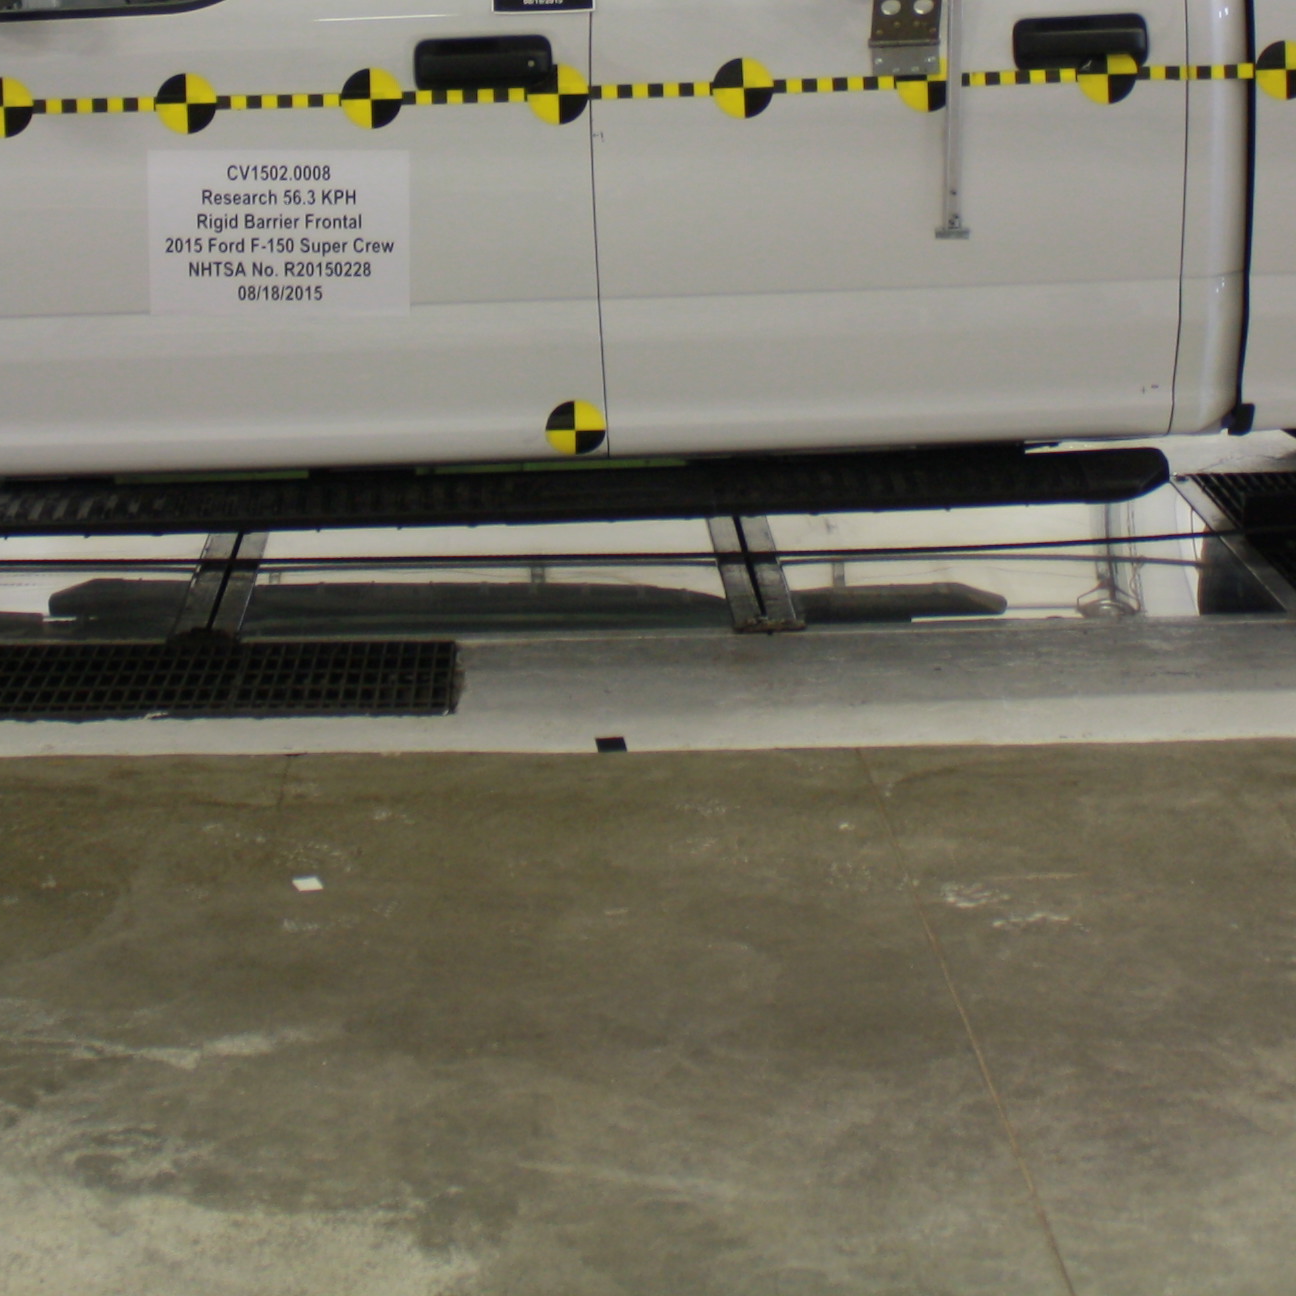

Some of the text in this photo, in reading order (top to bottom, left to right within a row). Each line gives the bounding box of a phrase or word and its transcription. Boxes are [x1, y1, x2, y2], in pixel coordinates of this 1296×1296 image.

[226, 165, 332, 182] CV1502.0008
[201, 189, 357, 206] Research 56.3 KPH
[196, 213, 362, 234] Rigid Barrier Frontal
[165, 237, 395, 257] 2015 Ford F-150 Super Crew
[188, 261, 372, 278] NHTSA No. R20150228
[237, 285, 323, 302] 08/18/2015
